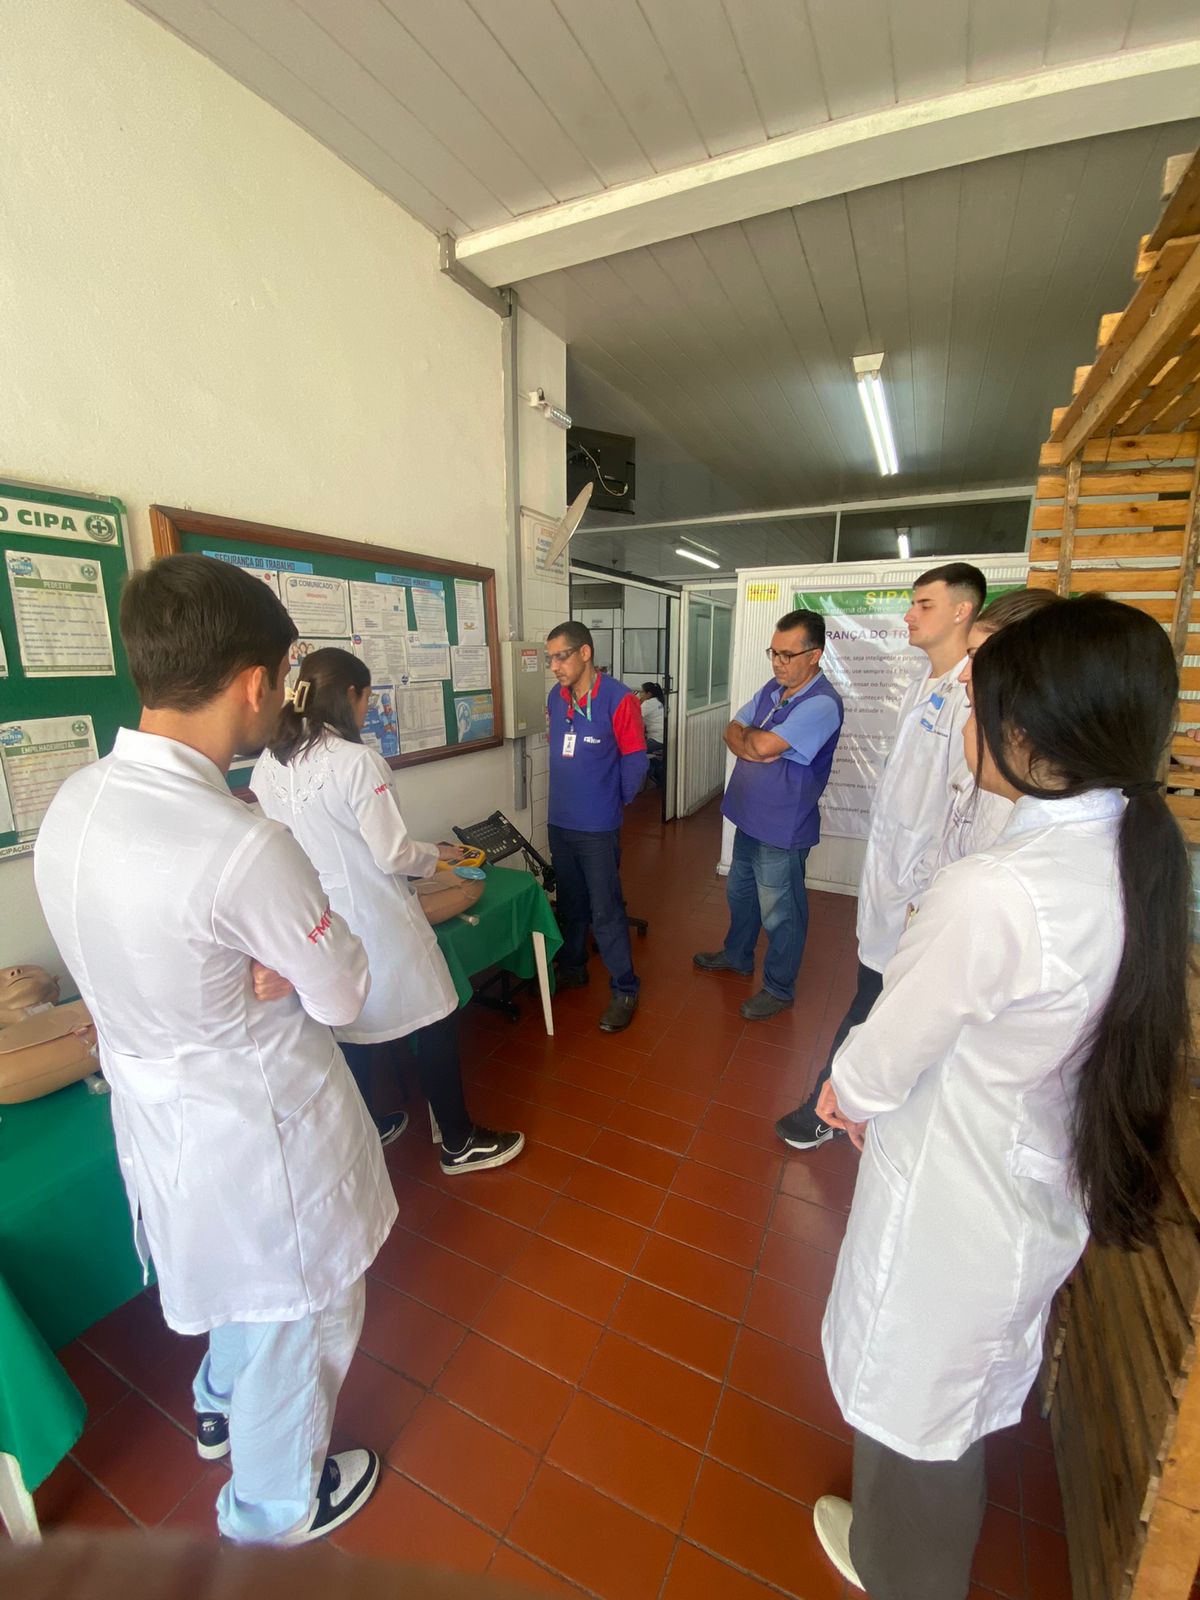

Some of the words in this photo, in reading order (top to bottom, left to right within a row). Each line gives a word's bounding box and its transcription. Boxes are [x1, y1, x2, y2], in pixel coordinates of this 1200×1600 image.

[17, 509, 78, 532] CIPA
[266, 559, 296, 571] TRABALHO
[825, 630, 867, 642] RANÇA
[869, 629, 889, 640] DO
[892, 629, 909, 639] TR
